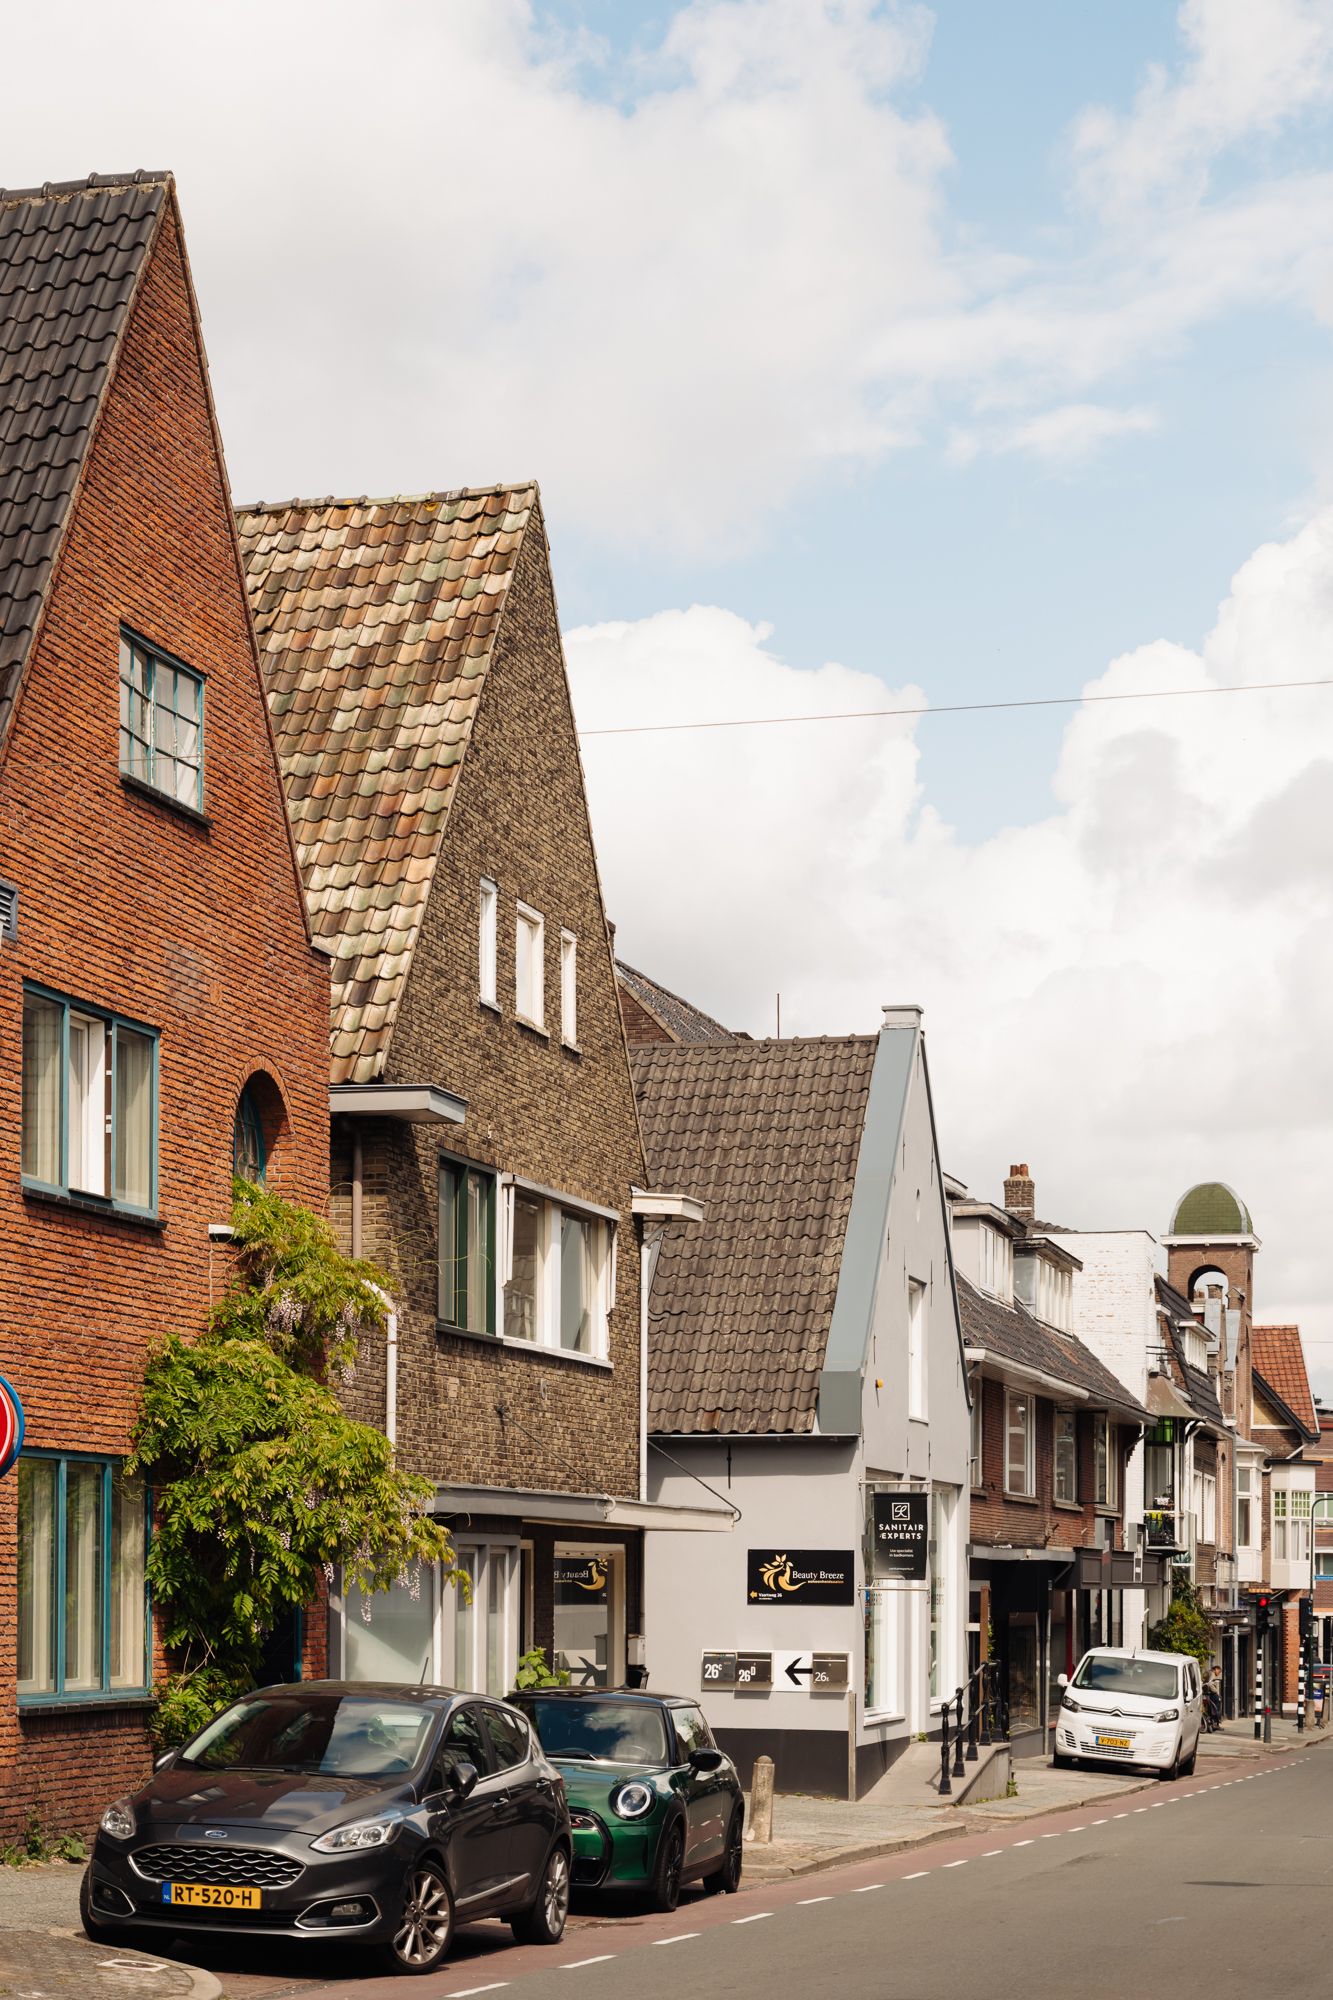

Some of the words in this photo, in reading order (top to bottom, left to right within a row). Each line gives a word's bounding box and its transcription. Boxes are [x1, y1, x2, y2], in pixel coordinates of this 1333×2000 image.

[879, 1523, 924, 1531] SANITAIR
[881, 1532, 922, 1540] EXPERTS
[792, 1570, 818, 1580] Beauty
[819, 1570, 845, 1580] Breeze
[1100, 1737, 1128, 1746] V-703-NZ
[174, 1885, 253, 1907] RT-520-H
